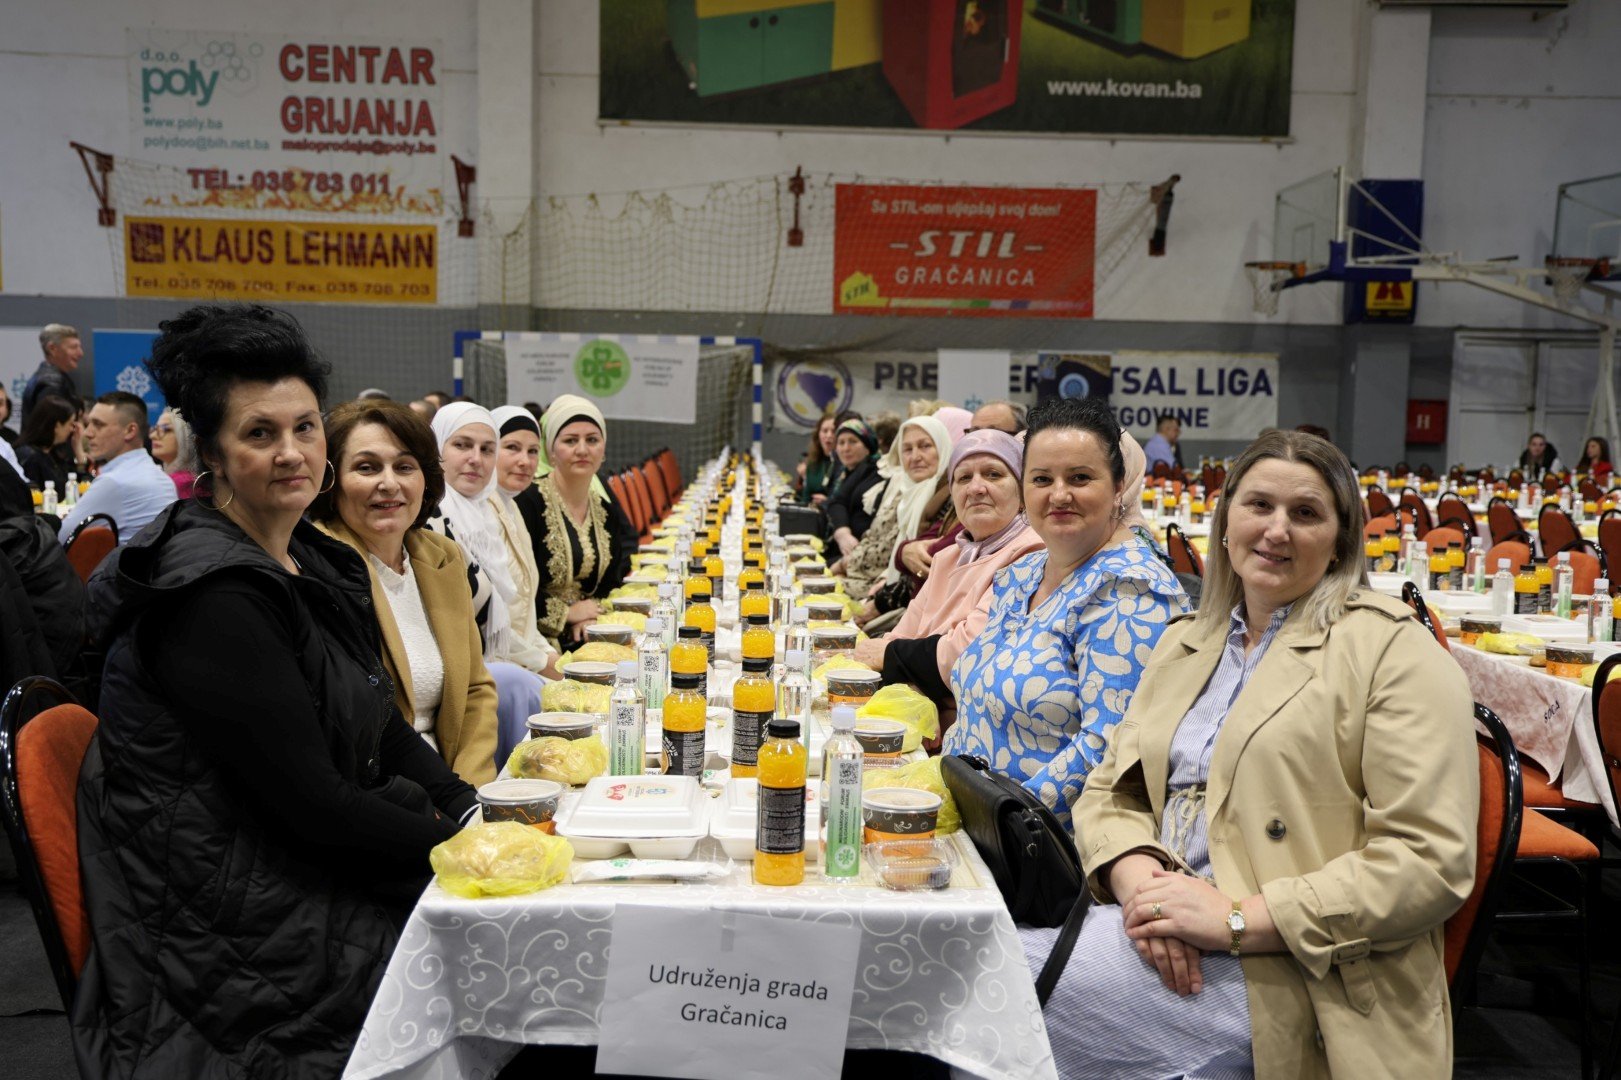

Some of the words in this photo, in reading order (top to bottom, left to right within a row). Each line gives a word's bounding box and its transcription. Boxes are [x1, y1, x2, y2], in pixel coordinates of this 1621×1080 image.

[279, 43, 436, 85] CENTAR
[141, 60, 220, 108] poly
[1047, 78, 1202, 100] www.kovan.ba
[143, 117, 223, 131] www.poly.ba
[280, 96, 436, 137] GRIJANJA
[143, 135, 270, 151] polydoo@bih.net.ba
[187, 168, 245, 190] TEL:
[252, 171, 295, 191] 035
[301, 172, 344, 193] 783
[350, 173, 391, 195] 011
[891, 199, 943, 215] STIL-om
[999, 202, 1027, 219] svoj
[172, 226, 275, 265] KLAUS
[285, 230, 434, 269] LEHMANN
[914, 231, 1016, 258] STIL
[326, 281, 358, 293] 035
[895, 265, 1035, 286] GRAČANICA
[1196, 367, 1273, 397] LIGA
[649, 964, 760, 995] Udruženja
[766, 980, 828, 1001] grada
[680, 1002, 788, 1031] Gračanica
